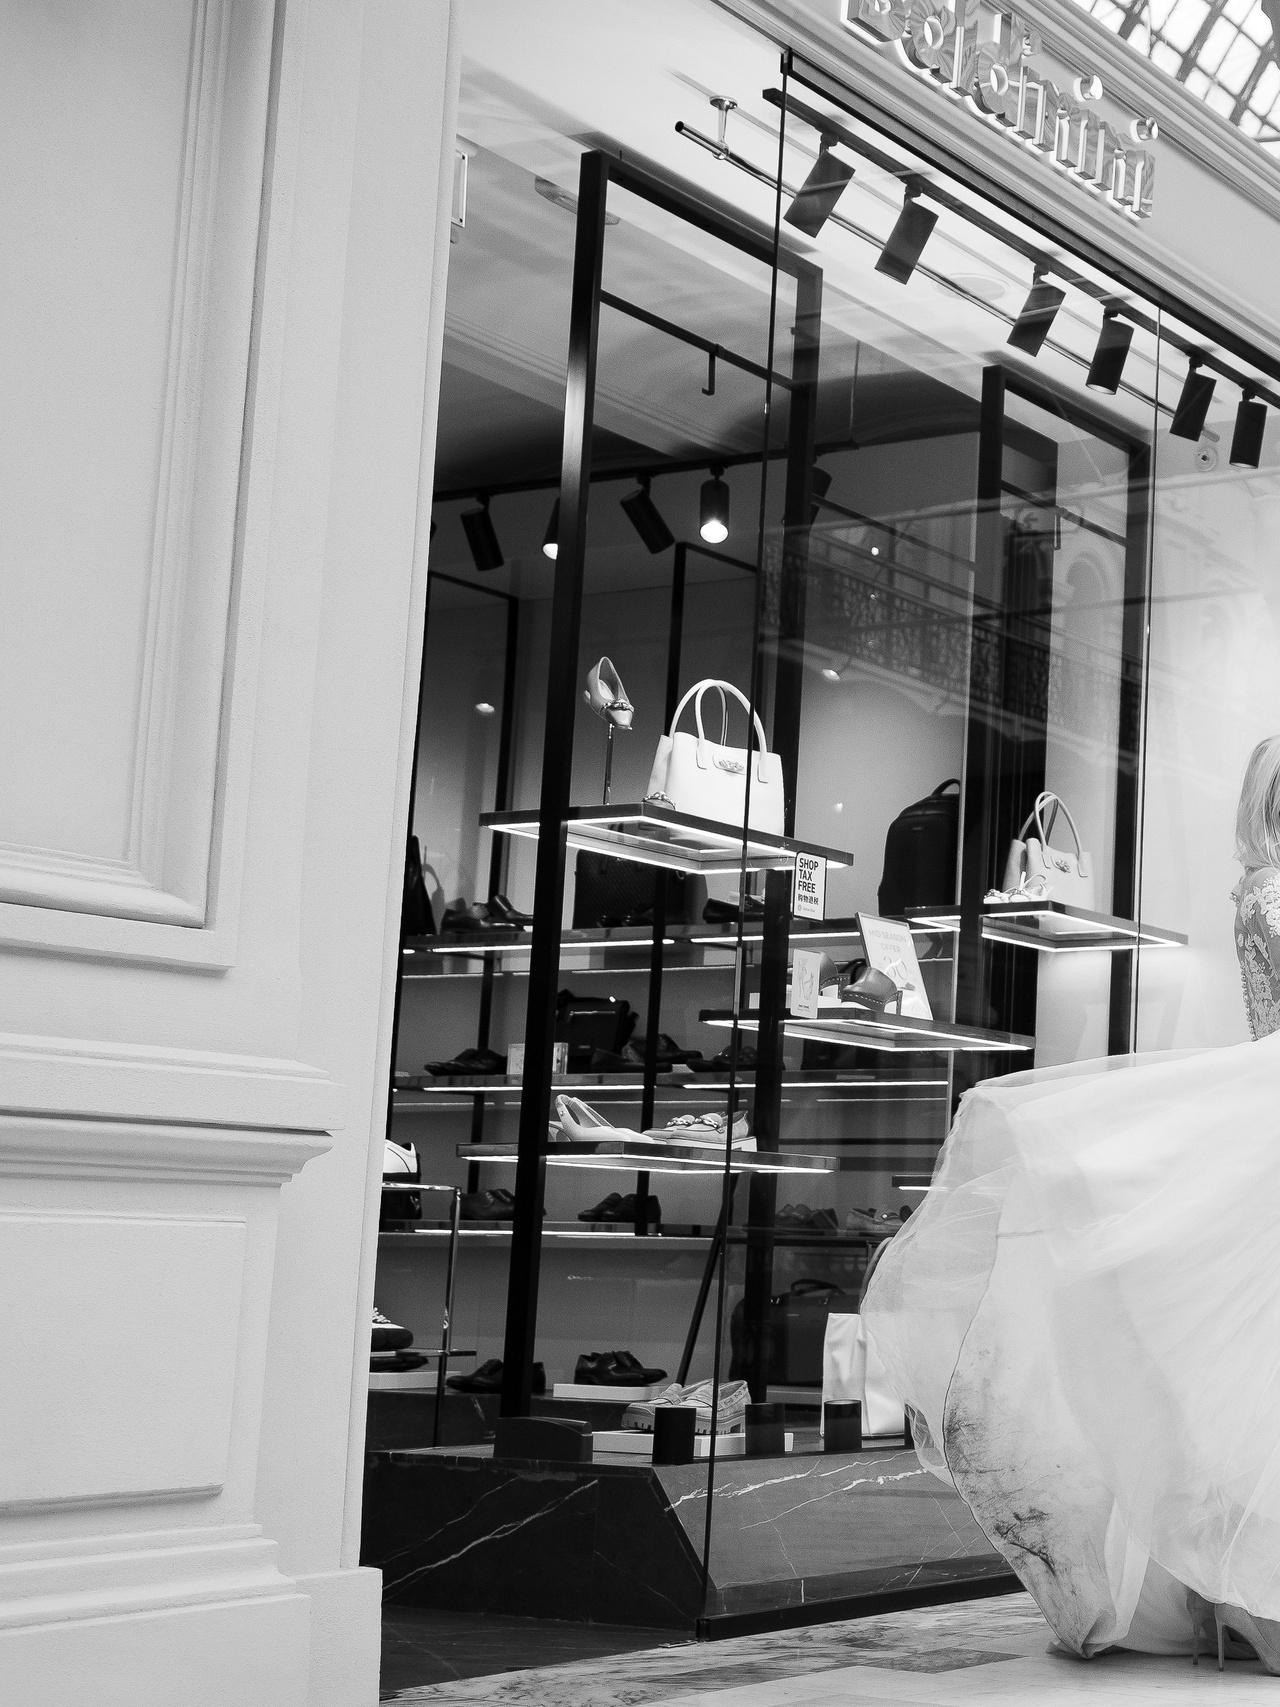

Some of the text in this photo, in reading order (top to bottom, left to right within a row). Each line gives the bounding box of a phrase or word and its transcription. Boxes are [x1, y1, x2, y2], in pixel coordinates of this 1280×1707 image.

[799, 857, 819, 871] SHOP
[799, 868, 813, 881] TAX
[798, 880, 816, 894] FREE
[868, 929, 907, 943] MID SEASON
[880, 942, 901, 953] OFFER
